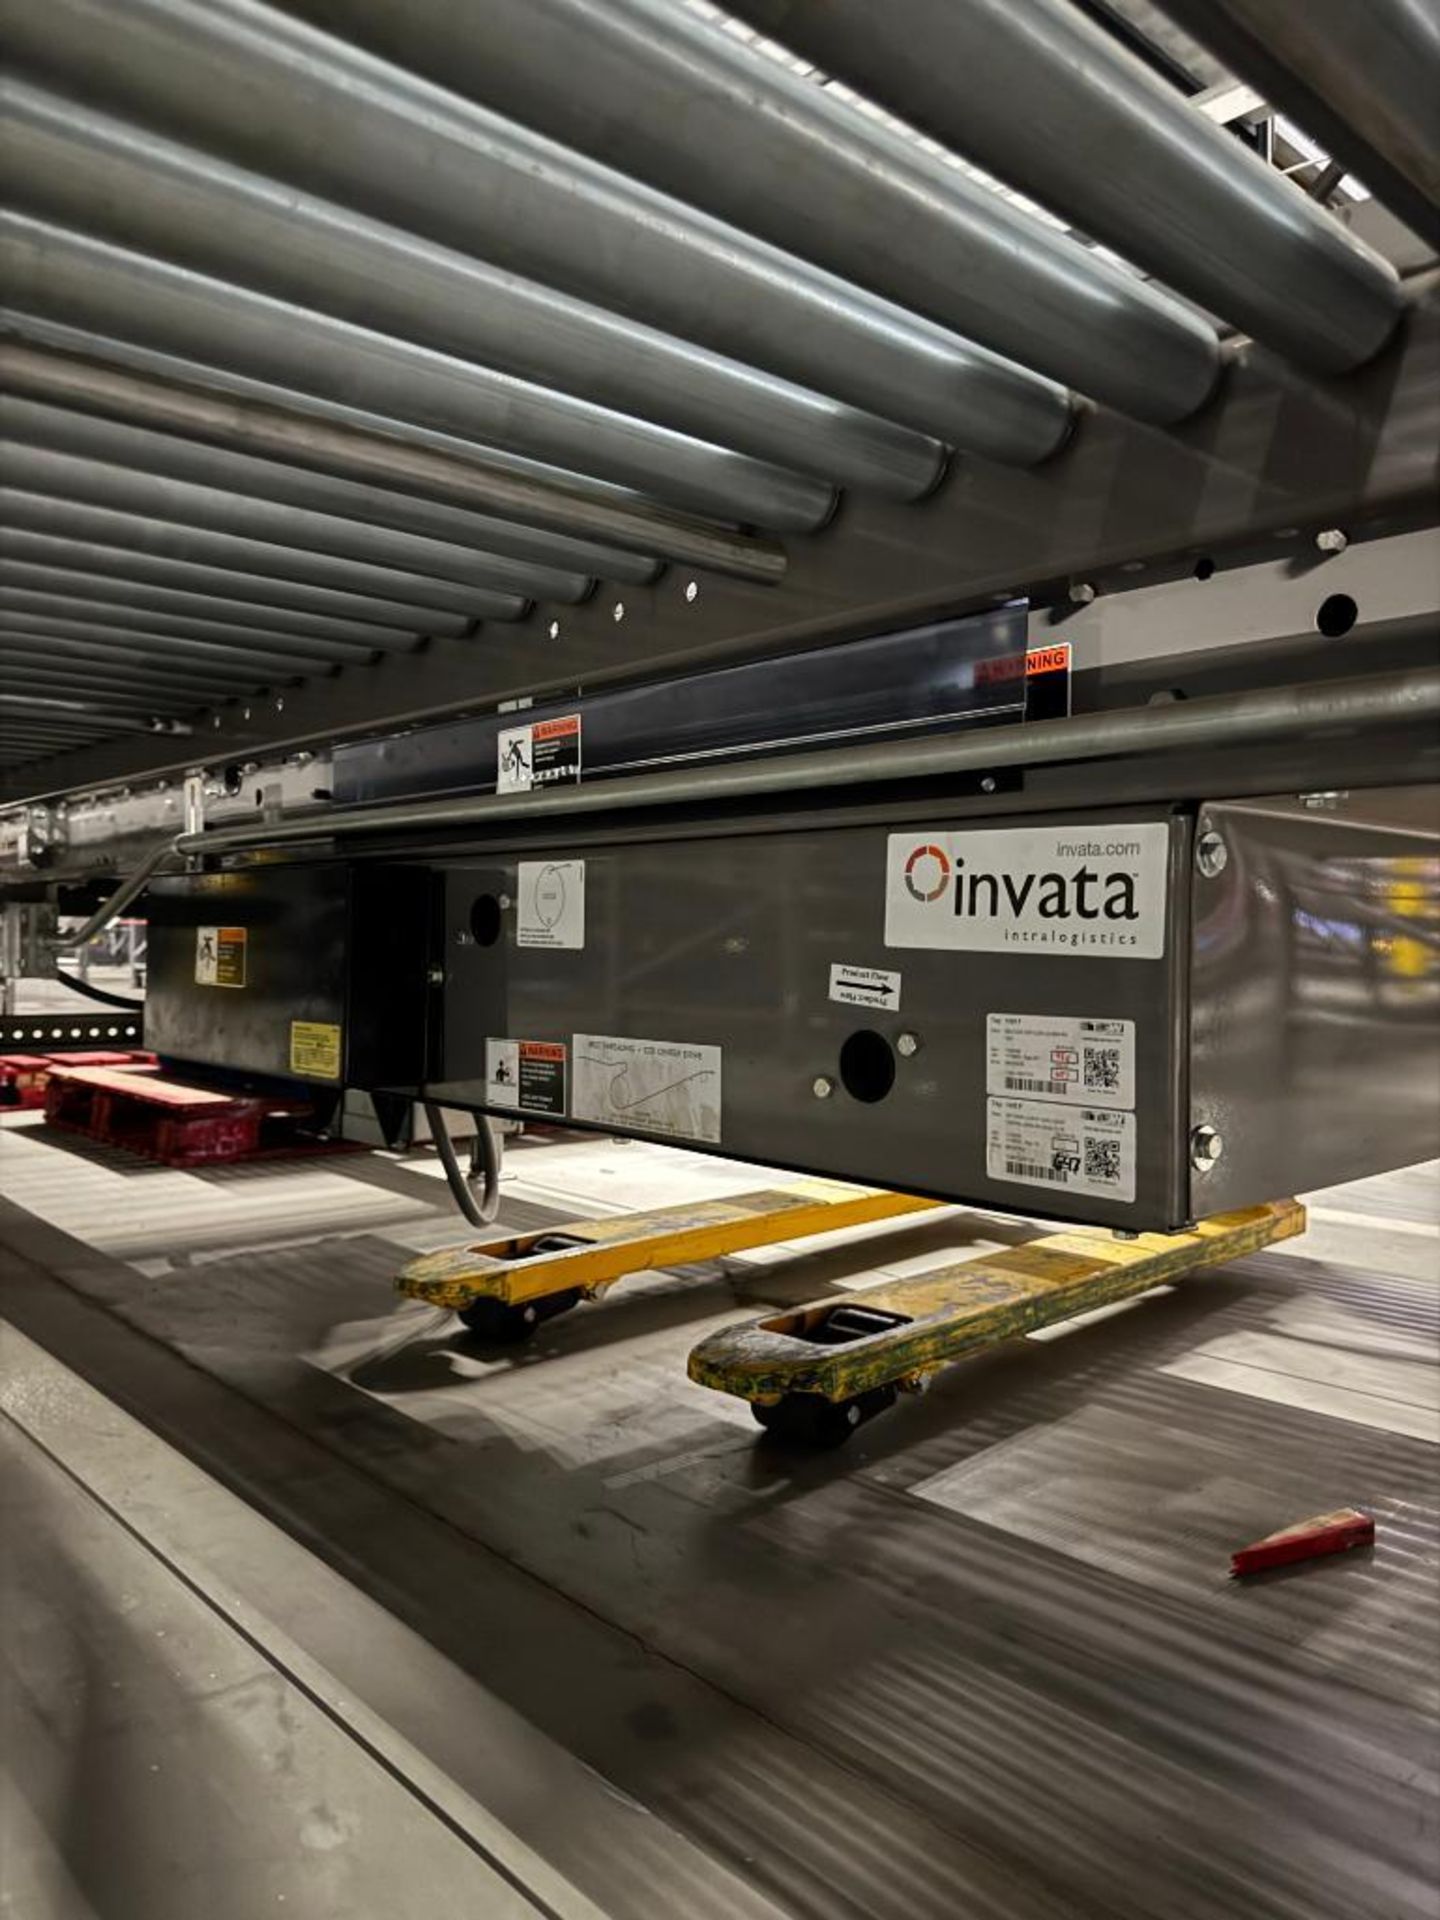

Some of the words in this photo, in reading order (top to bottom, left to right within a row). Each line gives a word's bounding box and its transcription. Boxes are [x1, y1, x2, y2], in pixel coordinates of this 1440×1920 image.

[1056, 841, 1141, 857] invata.com
[954, 857, 1139, 920] invata
[1004, 928, 1138, 947] intralogistics
